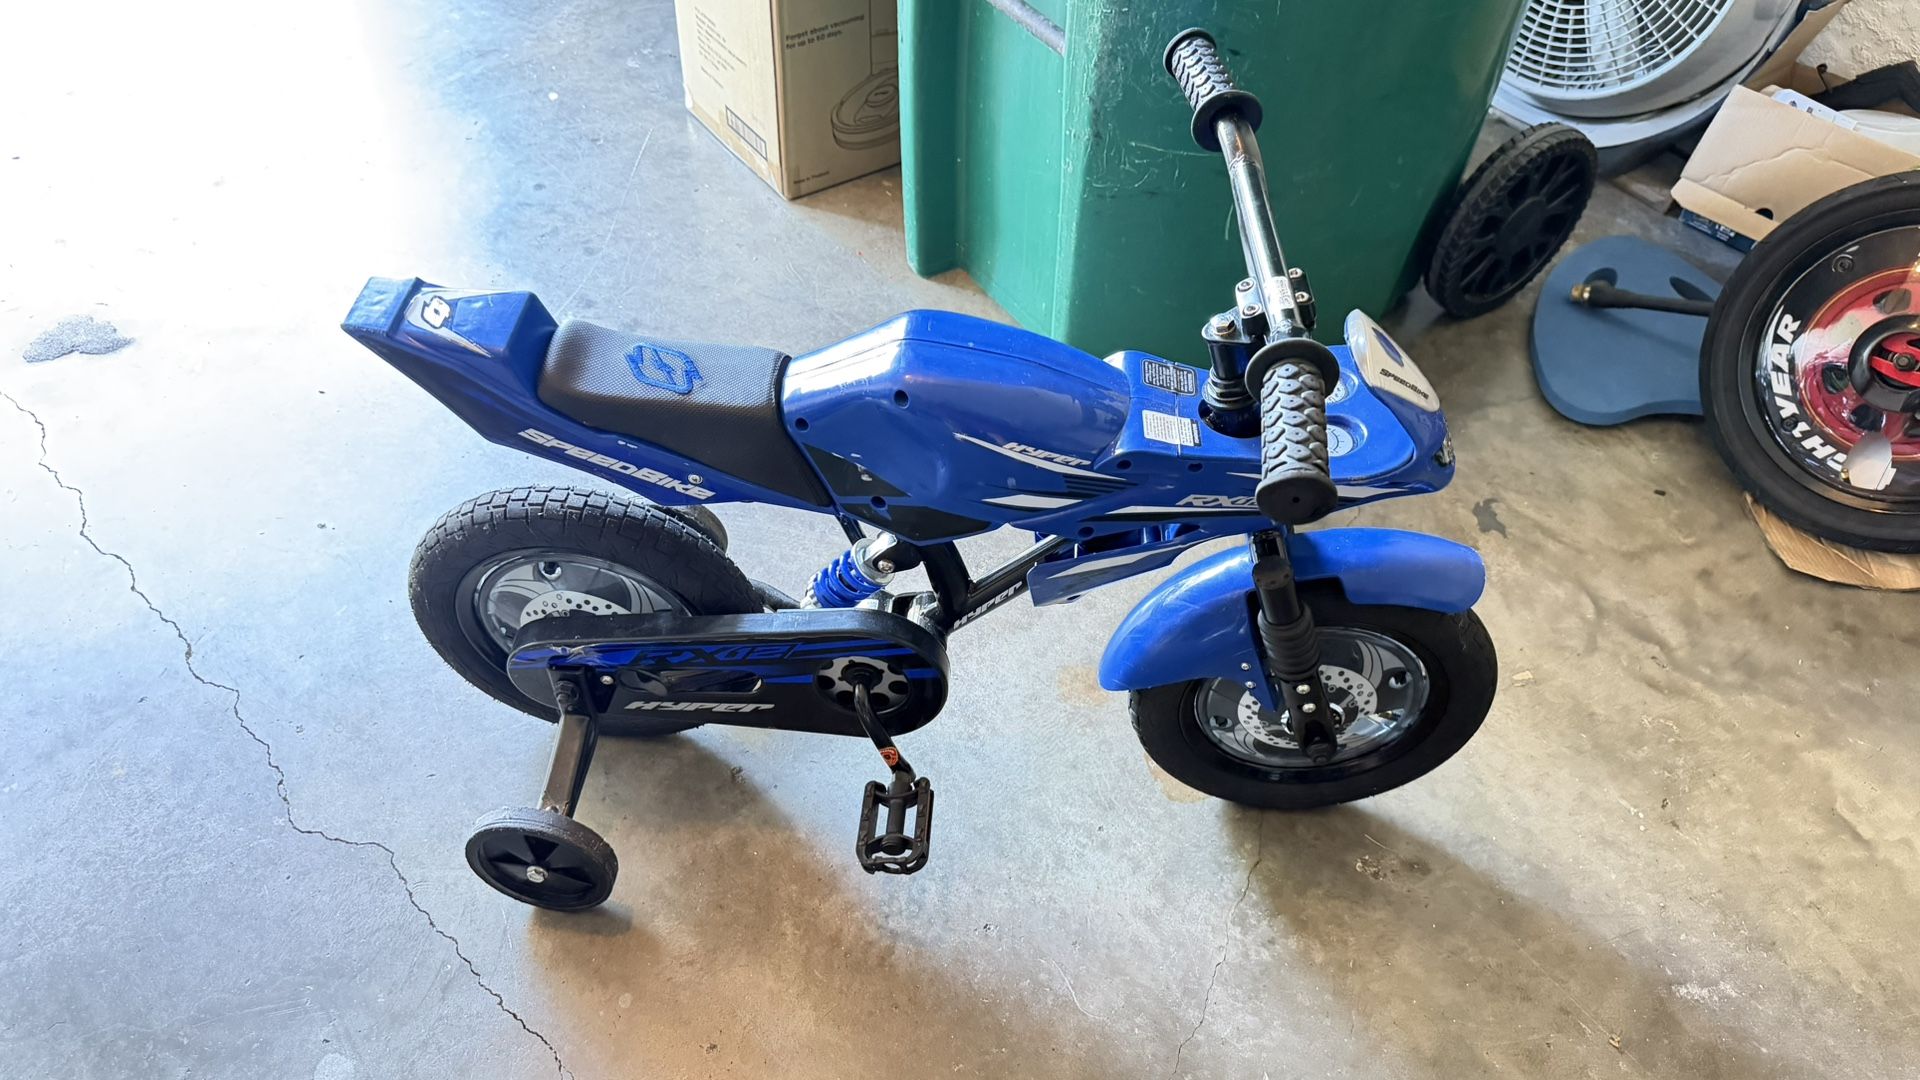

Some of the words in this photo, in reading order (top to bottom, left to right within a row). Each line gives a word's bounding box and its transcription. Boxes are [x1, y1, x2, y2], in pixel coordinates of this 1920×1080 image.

[786, 29, 808, 41] Forget
[810, 23, 829, 36] about
[518, 427, 716, 500] SPEEDBIKE
